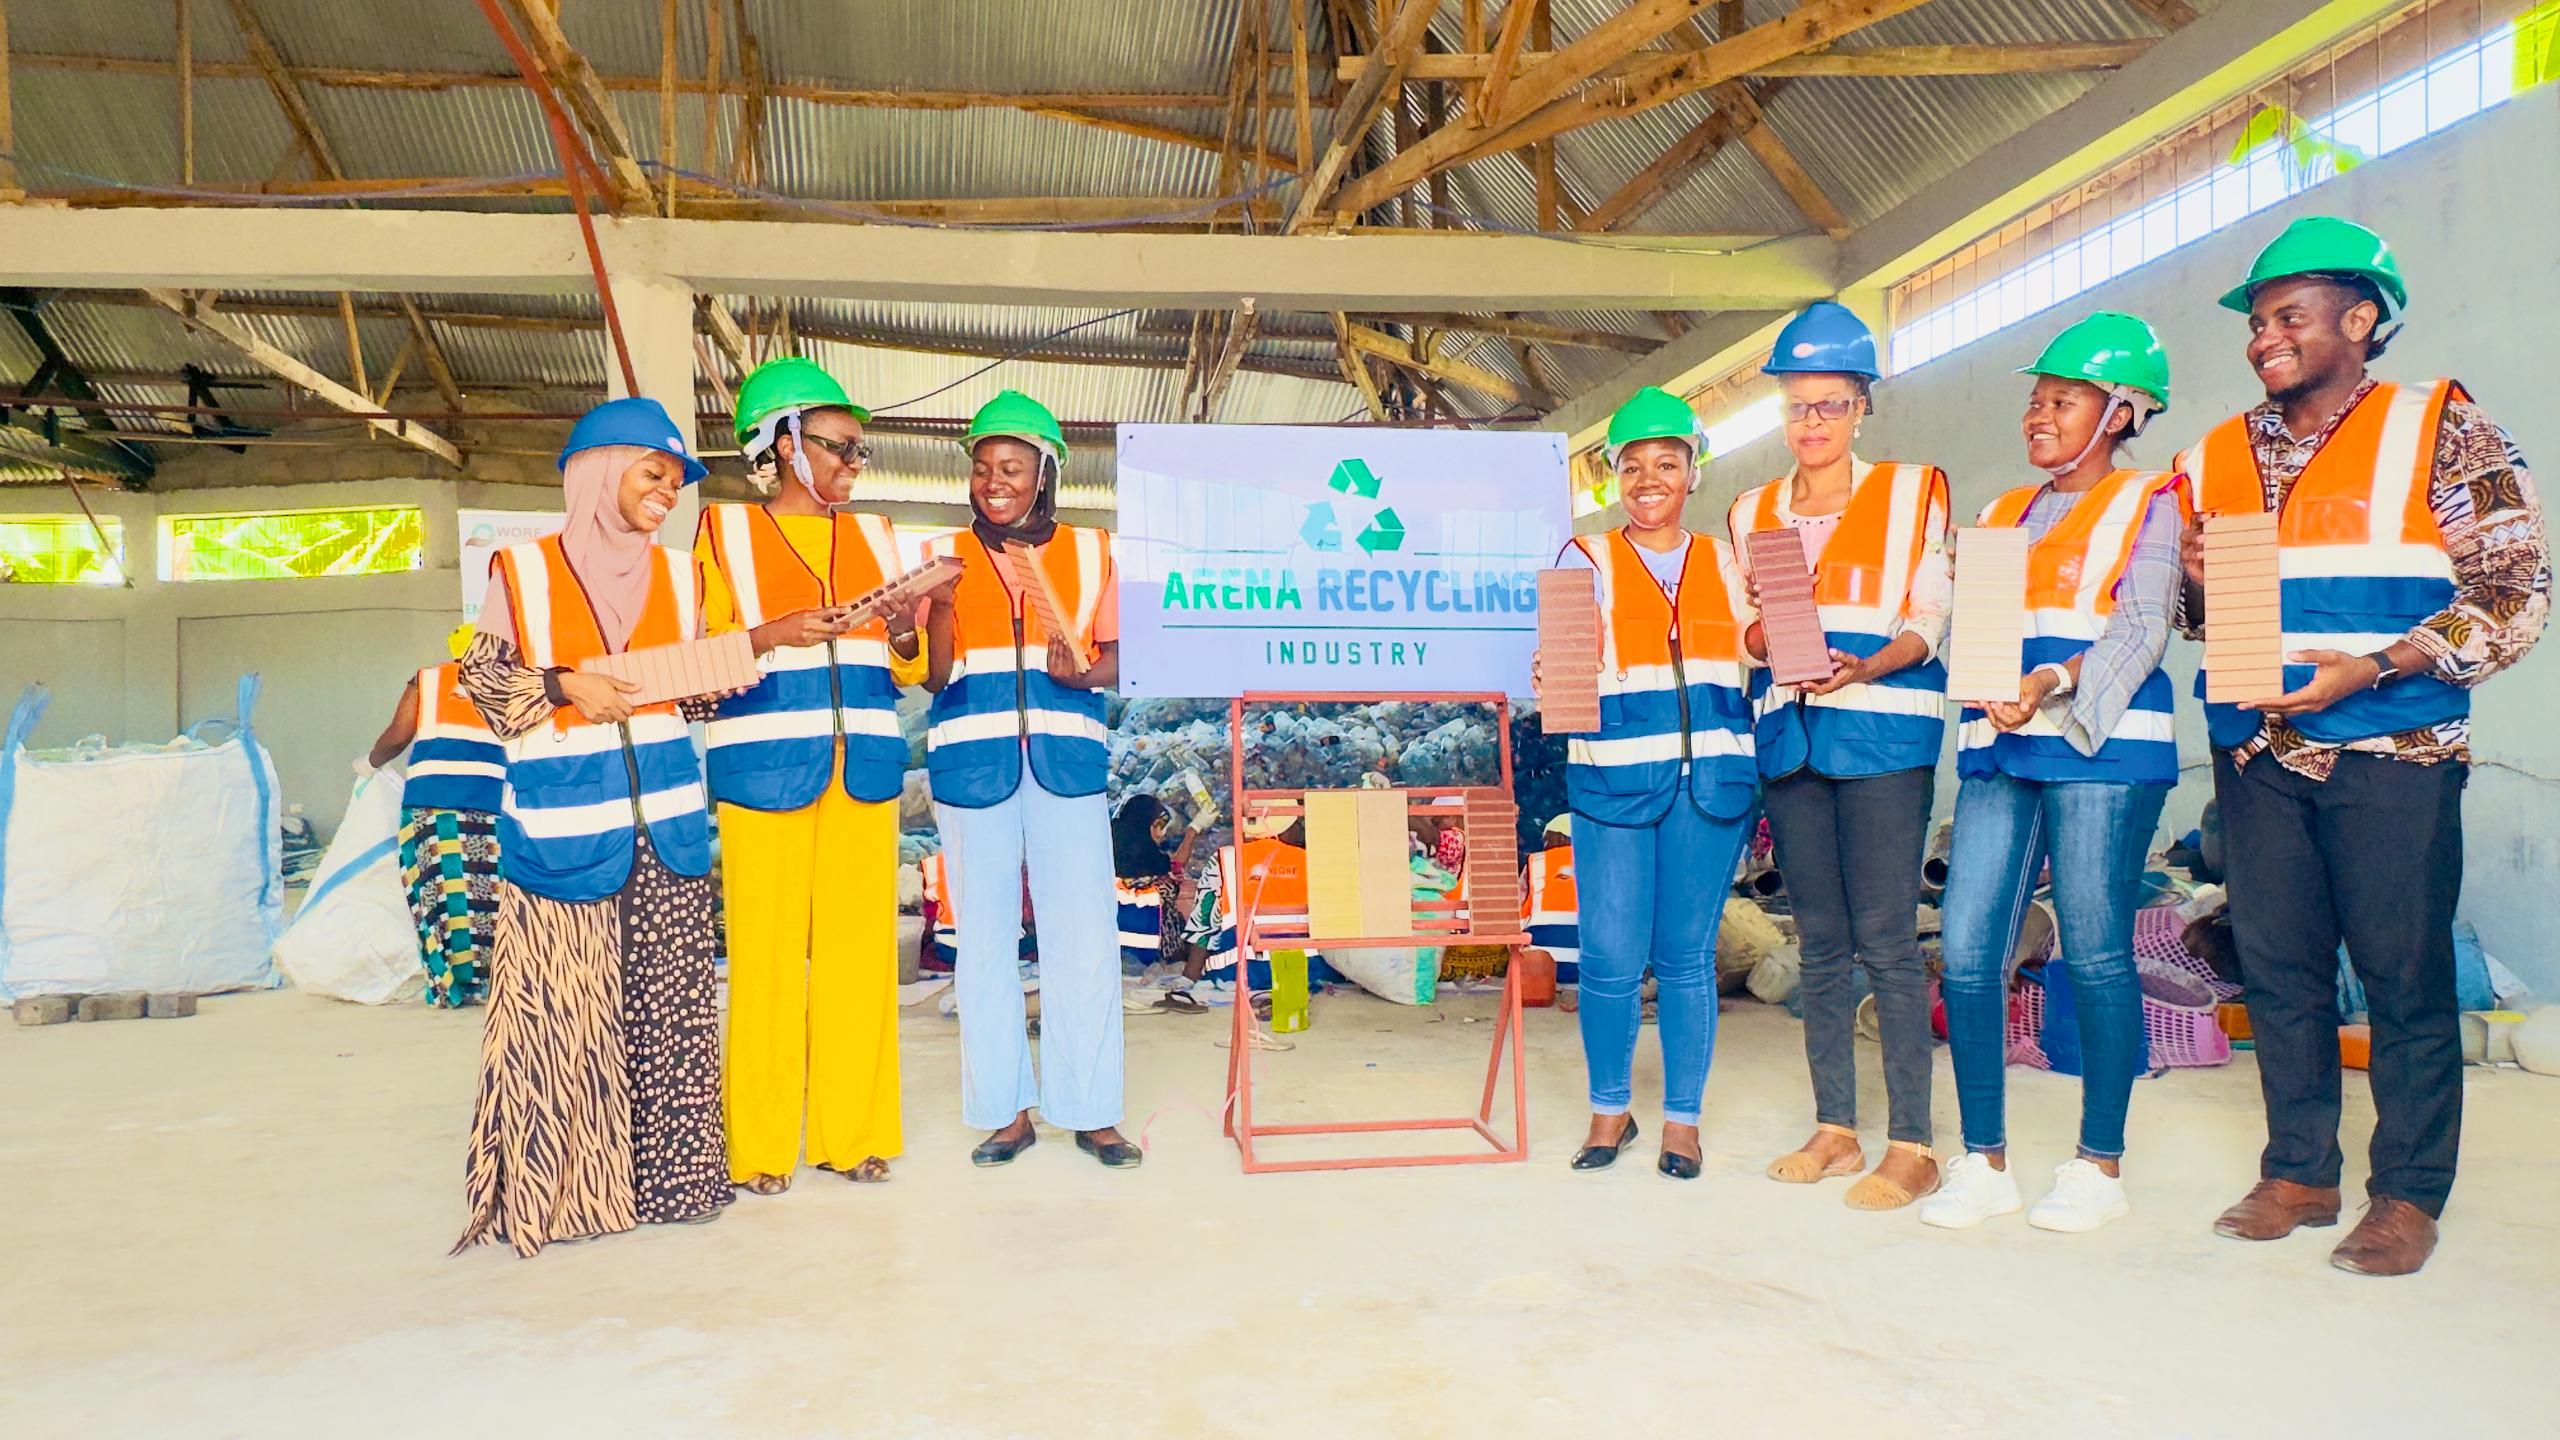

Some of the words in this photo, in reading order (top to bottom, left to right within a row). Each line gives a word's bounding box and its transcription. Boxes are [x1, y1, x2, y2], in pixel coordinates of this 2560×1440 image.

[1162, 568, 1302, 610] ARENA
[1317, 569, 1537, 613] RECYCLING
[1266, 641, 1427, 665] INDUSTRY
